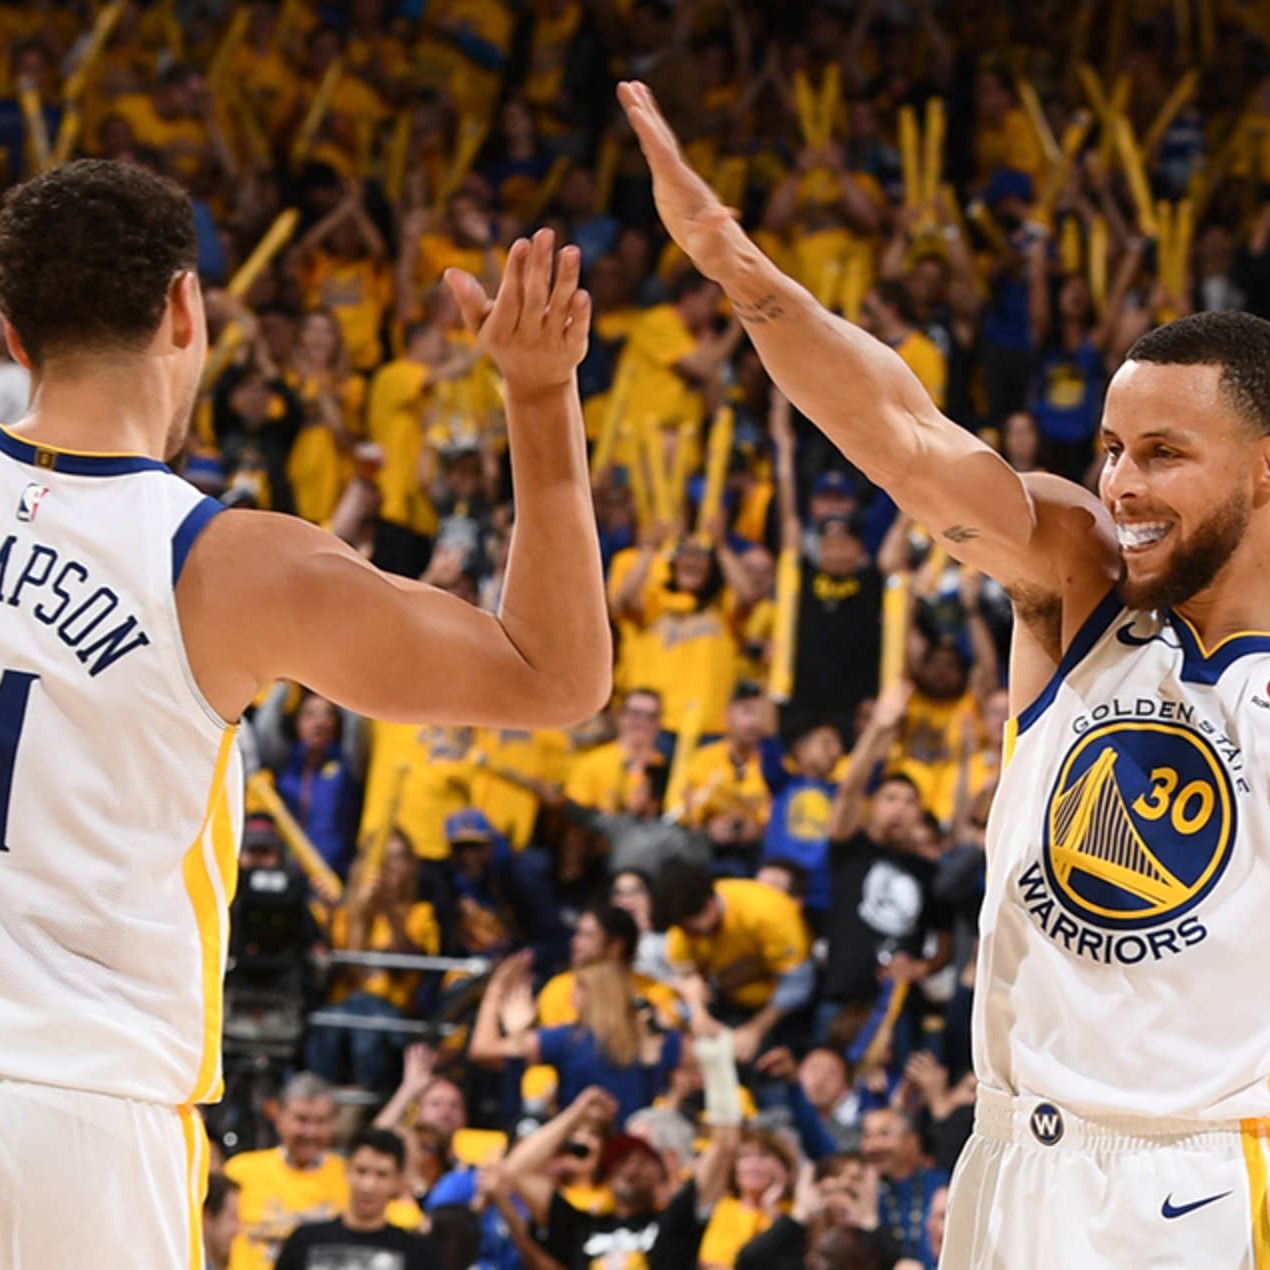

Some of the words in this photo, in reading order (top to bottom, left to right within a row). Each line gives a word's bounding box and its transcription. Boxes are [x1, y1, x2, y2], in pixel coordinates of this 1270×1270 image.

[1071, 698, 1195, 735] GOLDEN
[1131, 767, 1216, 835] 30
[1017, 861, 1208, 965] WARRIORS
[1033, 1113, 1059, 1136] W
